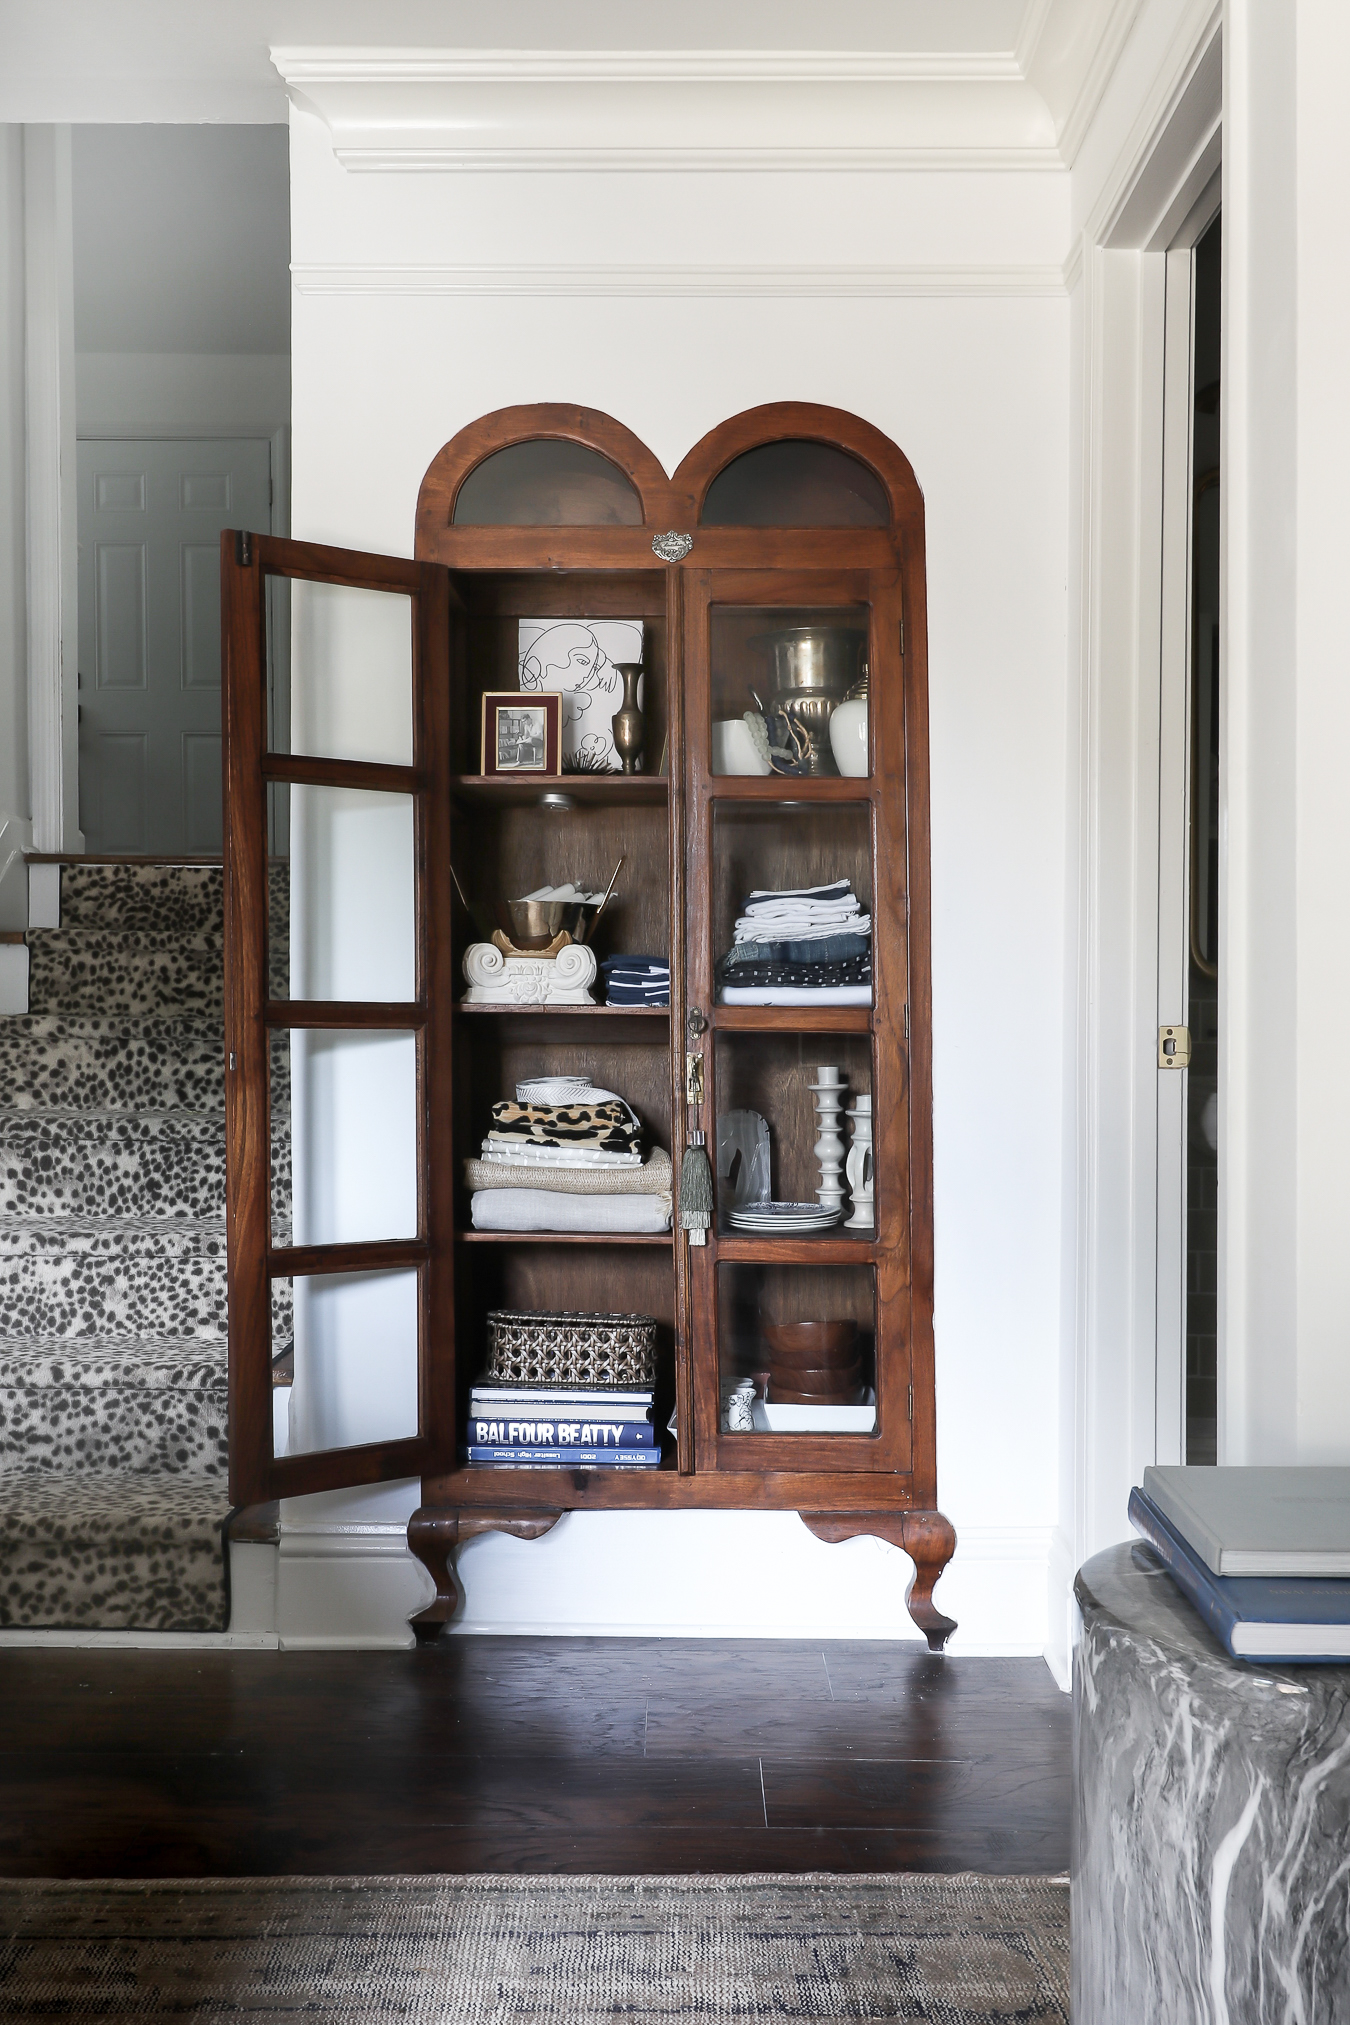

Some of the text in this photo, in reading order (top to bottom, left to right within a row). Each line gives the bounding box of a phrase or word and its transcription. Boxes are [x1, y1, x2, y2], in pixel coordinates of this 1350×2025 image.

[476, 1422, 624, 1447] BALFOUR BEATTY
[493, 1450, 515, 1458] School
[518, 1451, 531, 1459] High
[614, 1453, 646, 1461] ODYSSEY
